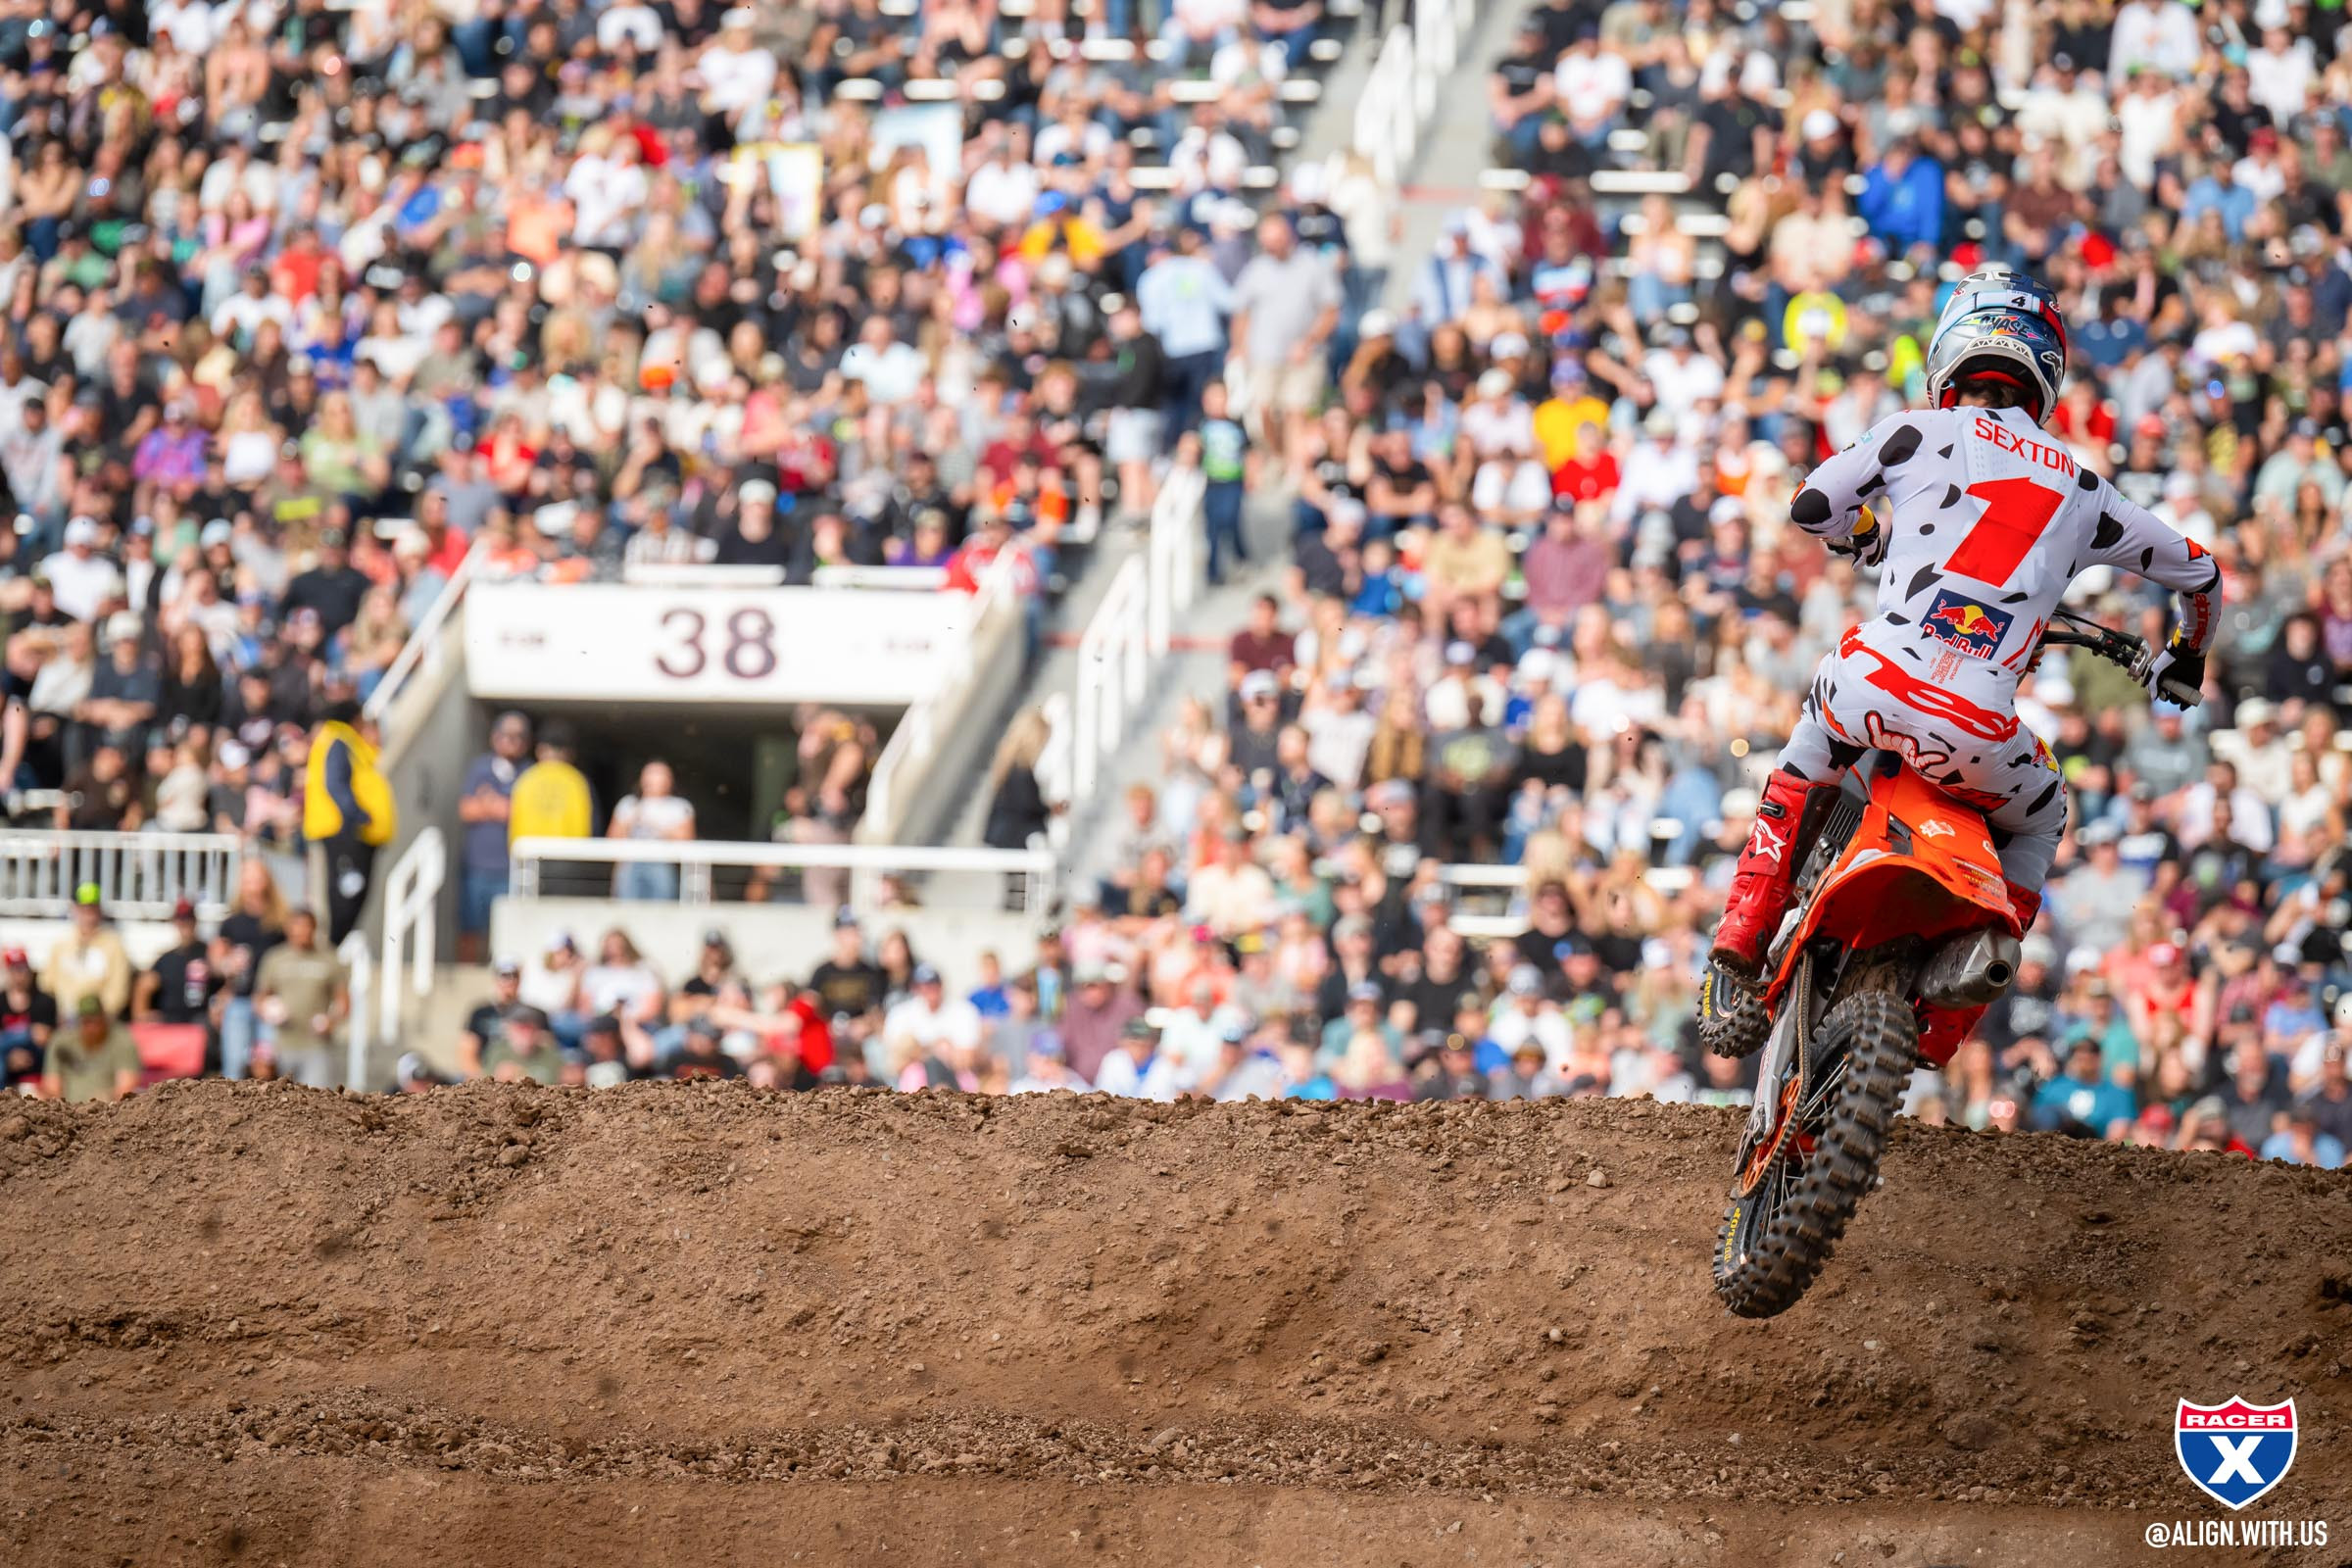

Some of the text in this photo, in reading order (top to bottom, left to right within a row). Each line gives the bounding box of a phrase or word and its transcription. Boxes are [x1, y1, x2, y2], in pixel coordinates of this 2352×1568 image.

[2011, 296, 2026, 307] 4
[1975, 416, 2075, 479] SEXTON
[1943, 476, 2065, 588] 1
[655, 607, 777, 679] 38
[1724, 1206, 1741, 1263] DUNLOP
